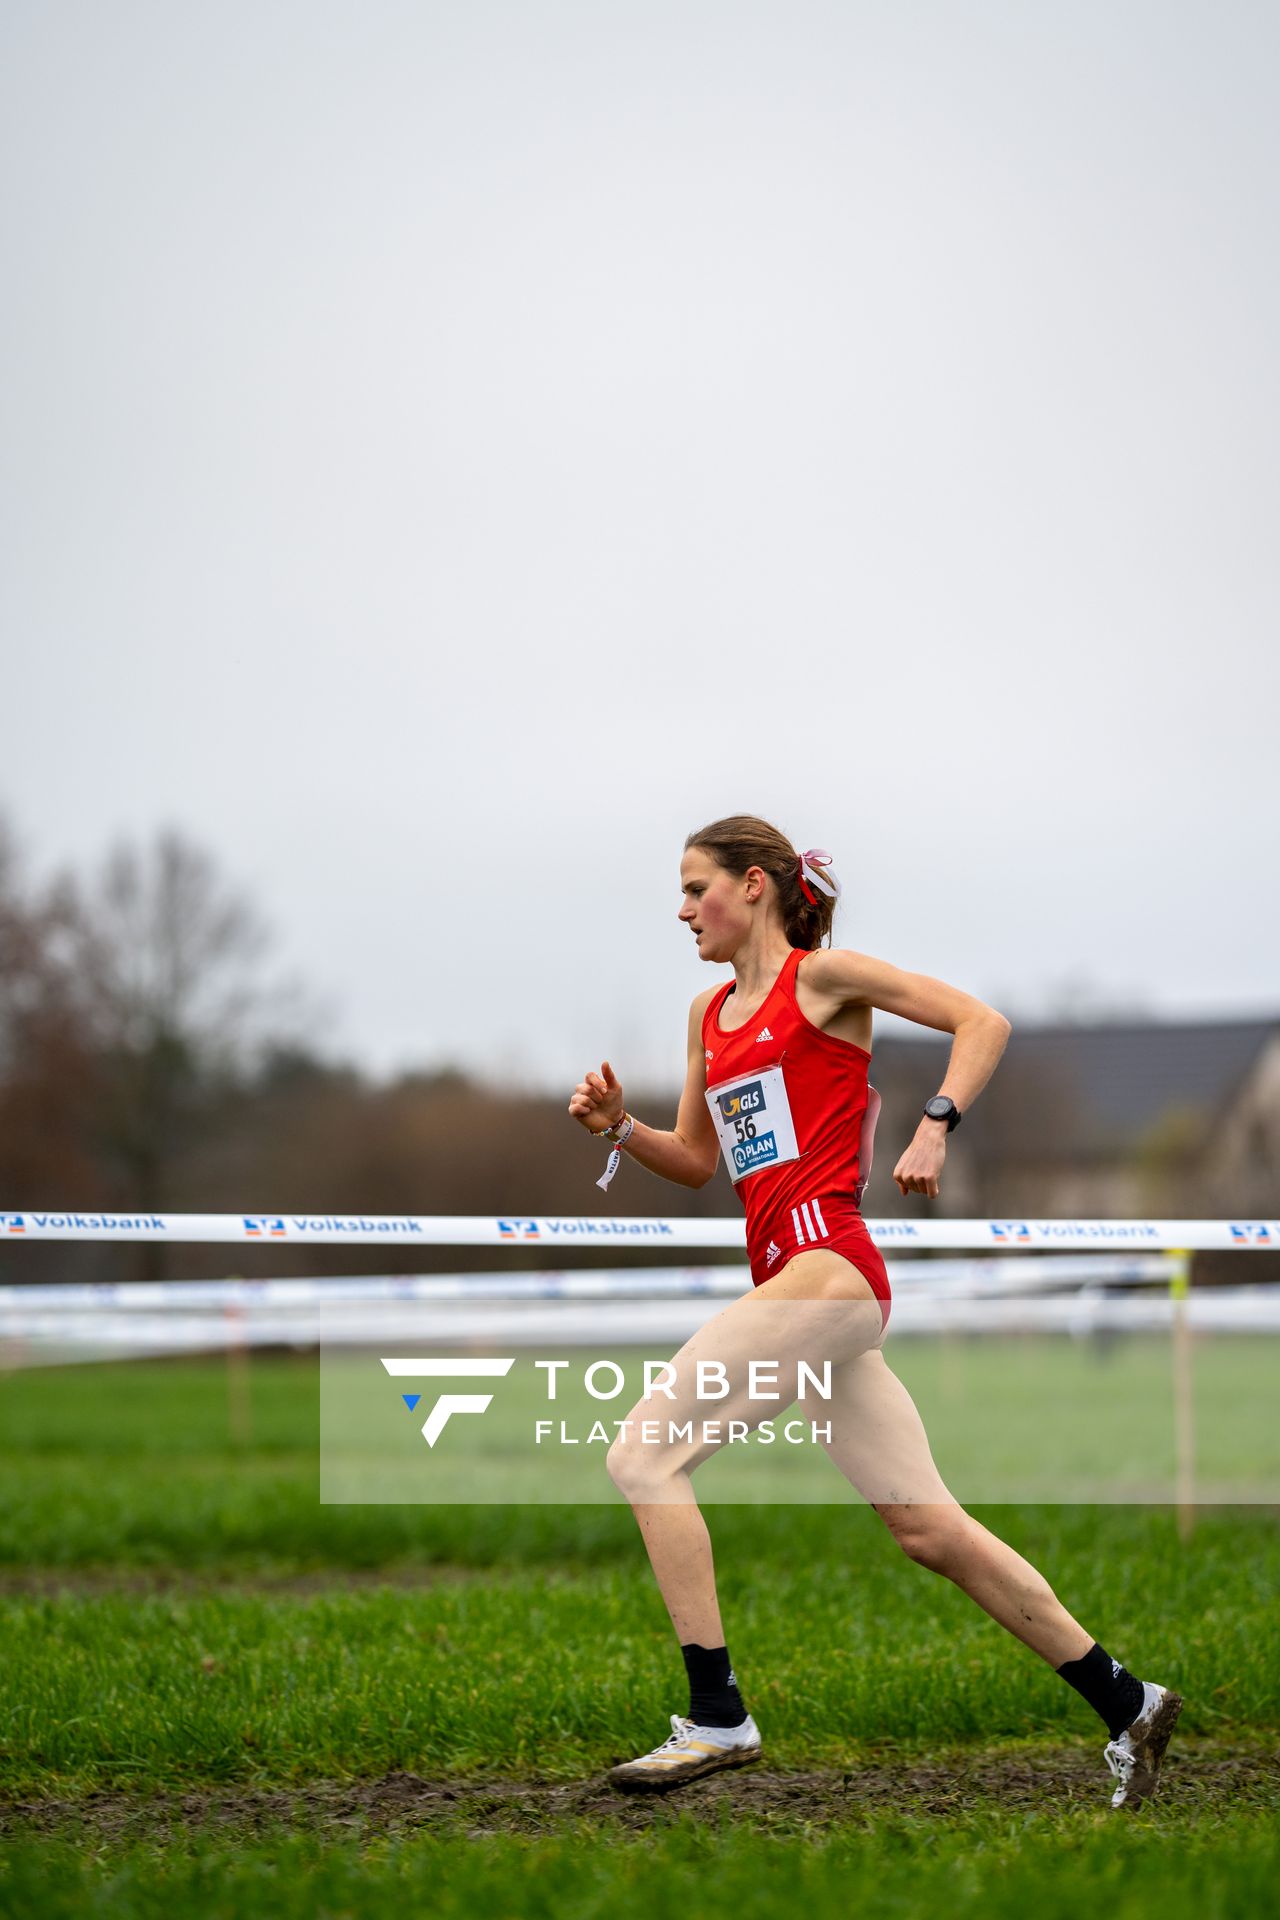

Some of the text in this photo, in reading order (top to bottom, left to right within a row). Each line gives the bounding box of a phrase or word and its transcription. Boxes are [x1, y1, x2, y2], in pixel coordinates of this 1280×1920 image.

[740, 1090, 760, 1111] GLS
[734, 1115, 757, 1144] 56
[745, 1137, 774, 1157] PLAN
[32, 1214, 167, 1230] Volksbank
[292, 1217, 423, 1233] Volksbank
[546, 1219, 673, 1235] Volksbank
[1036, 1223, 1159, 1239] Volksbank
